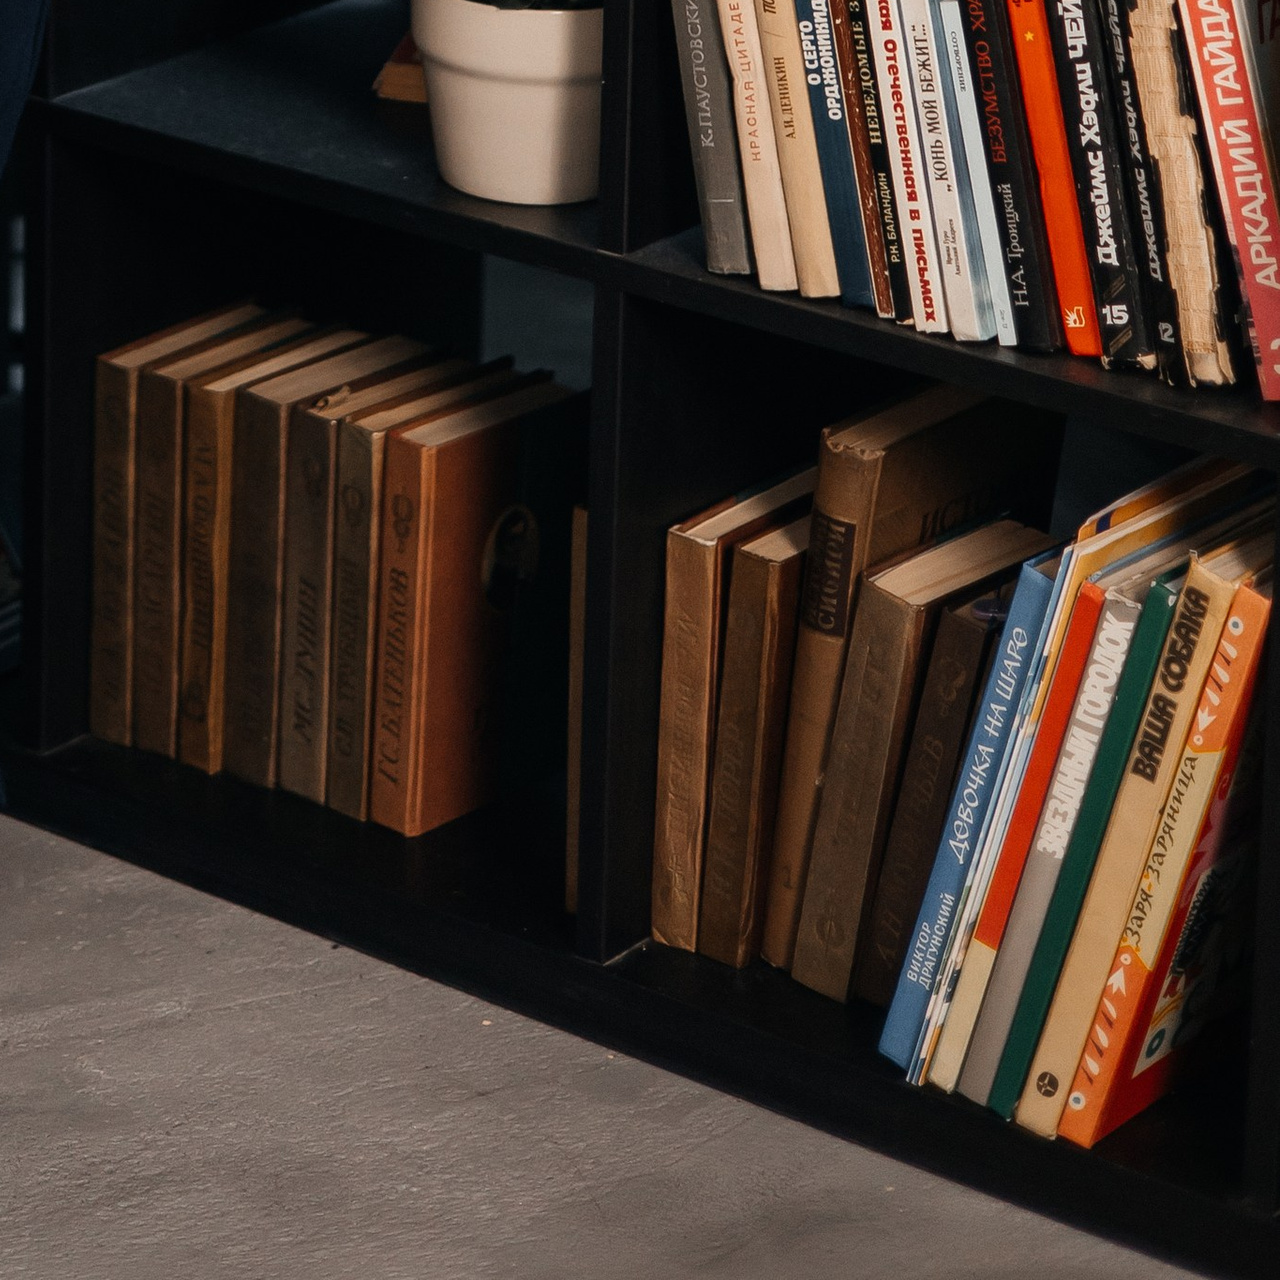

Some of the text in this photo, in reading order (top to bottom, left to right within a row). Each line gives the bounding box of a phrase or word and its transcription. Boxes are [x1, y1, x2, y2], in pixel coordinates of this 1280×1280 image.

[798, 19, 821, 86] О СЕРГО
[851, 20, 884, 145] НЕВЕДОМЫЕ
[950, 30, 967, 92] СОТВОРЕНИЕ
[974, 39, 1007, 164] БЕЗУМСТВО
[743, 80, 762, 162] КРАСНАЯ
[920, 99, 941, 137] МОЙ
[1077, 61, 1104, 146] Хэдли
[876, 171, 897, 240] БАЛАНДИН
[882, 37, 920, 203] Отечественная
[910, 227, 937, 323] письмах
[1084, 149, 1119, 268] Джеймс
[1132, 166, 1164, 282] Джеймс
[1217, 116, 1280, 288] АРКАДИЙ
[996, 182, 1029, 308] Н.А. Троицкий
[1101, 304, 1129, 327] 15
[980, 700, 1008, 739] НА
[1128, 584, 1214, 783] ВАША СОБАКА
[1033, 610, 1136, 859] ЗВЕЗДНЫЙ ГОРОДОК
[905, 921, 933, 981] ВИКТОР
[916, 891, 956, 989] ДРАГУНСКИЙ
